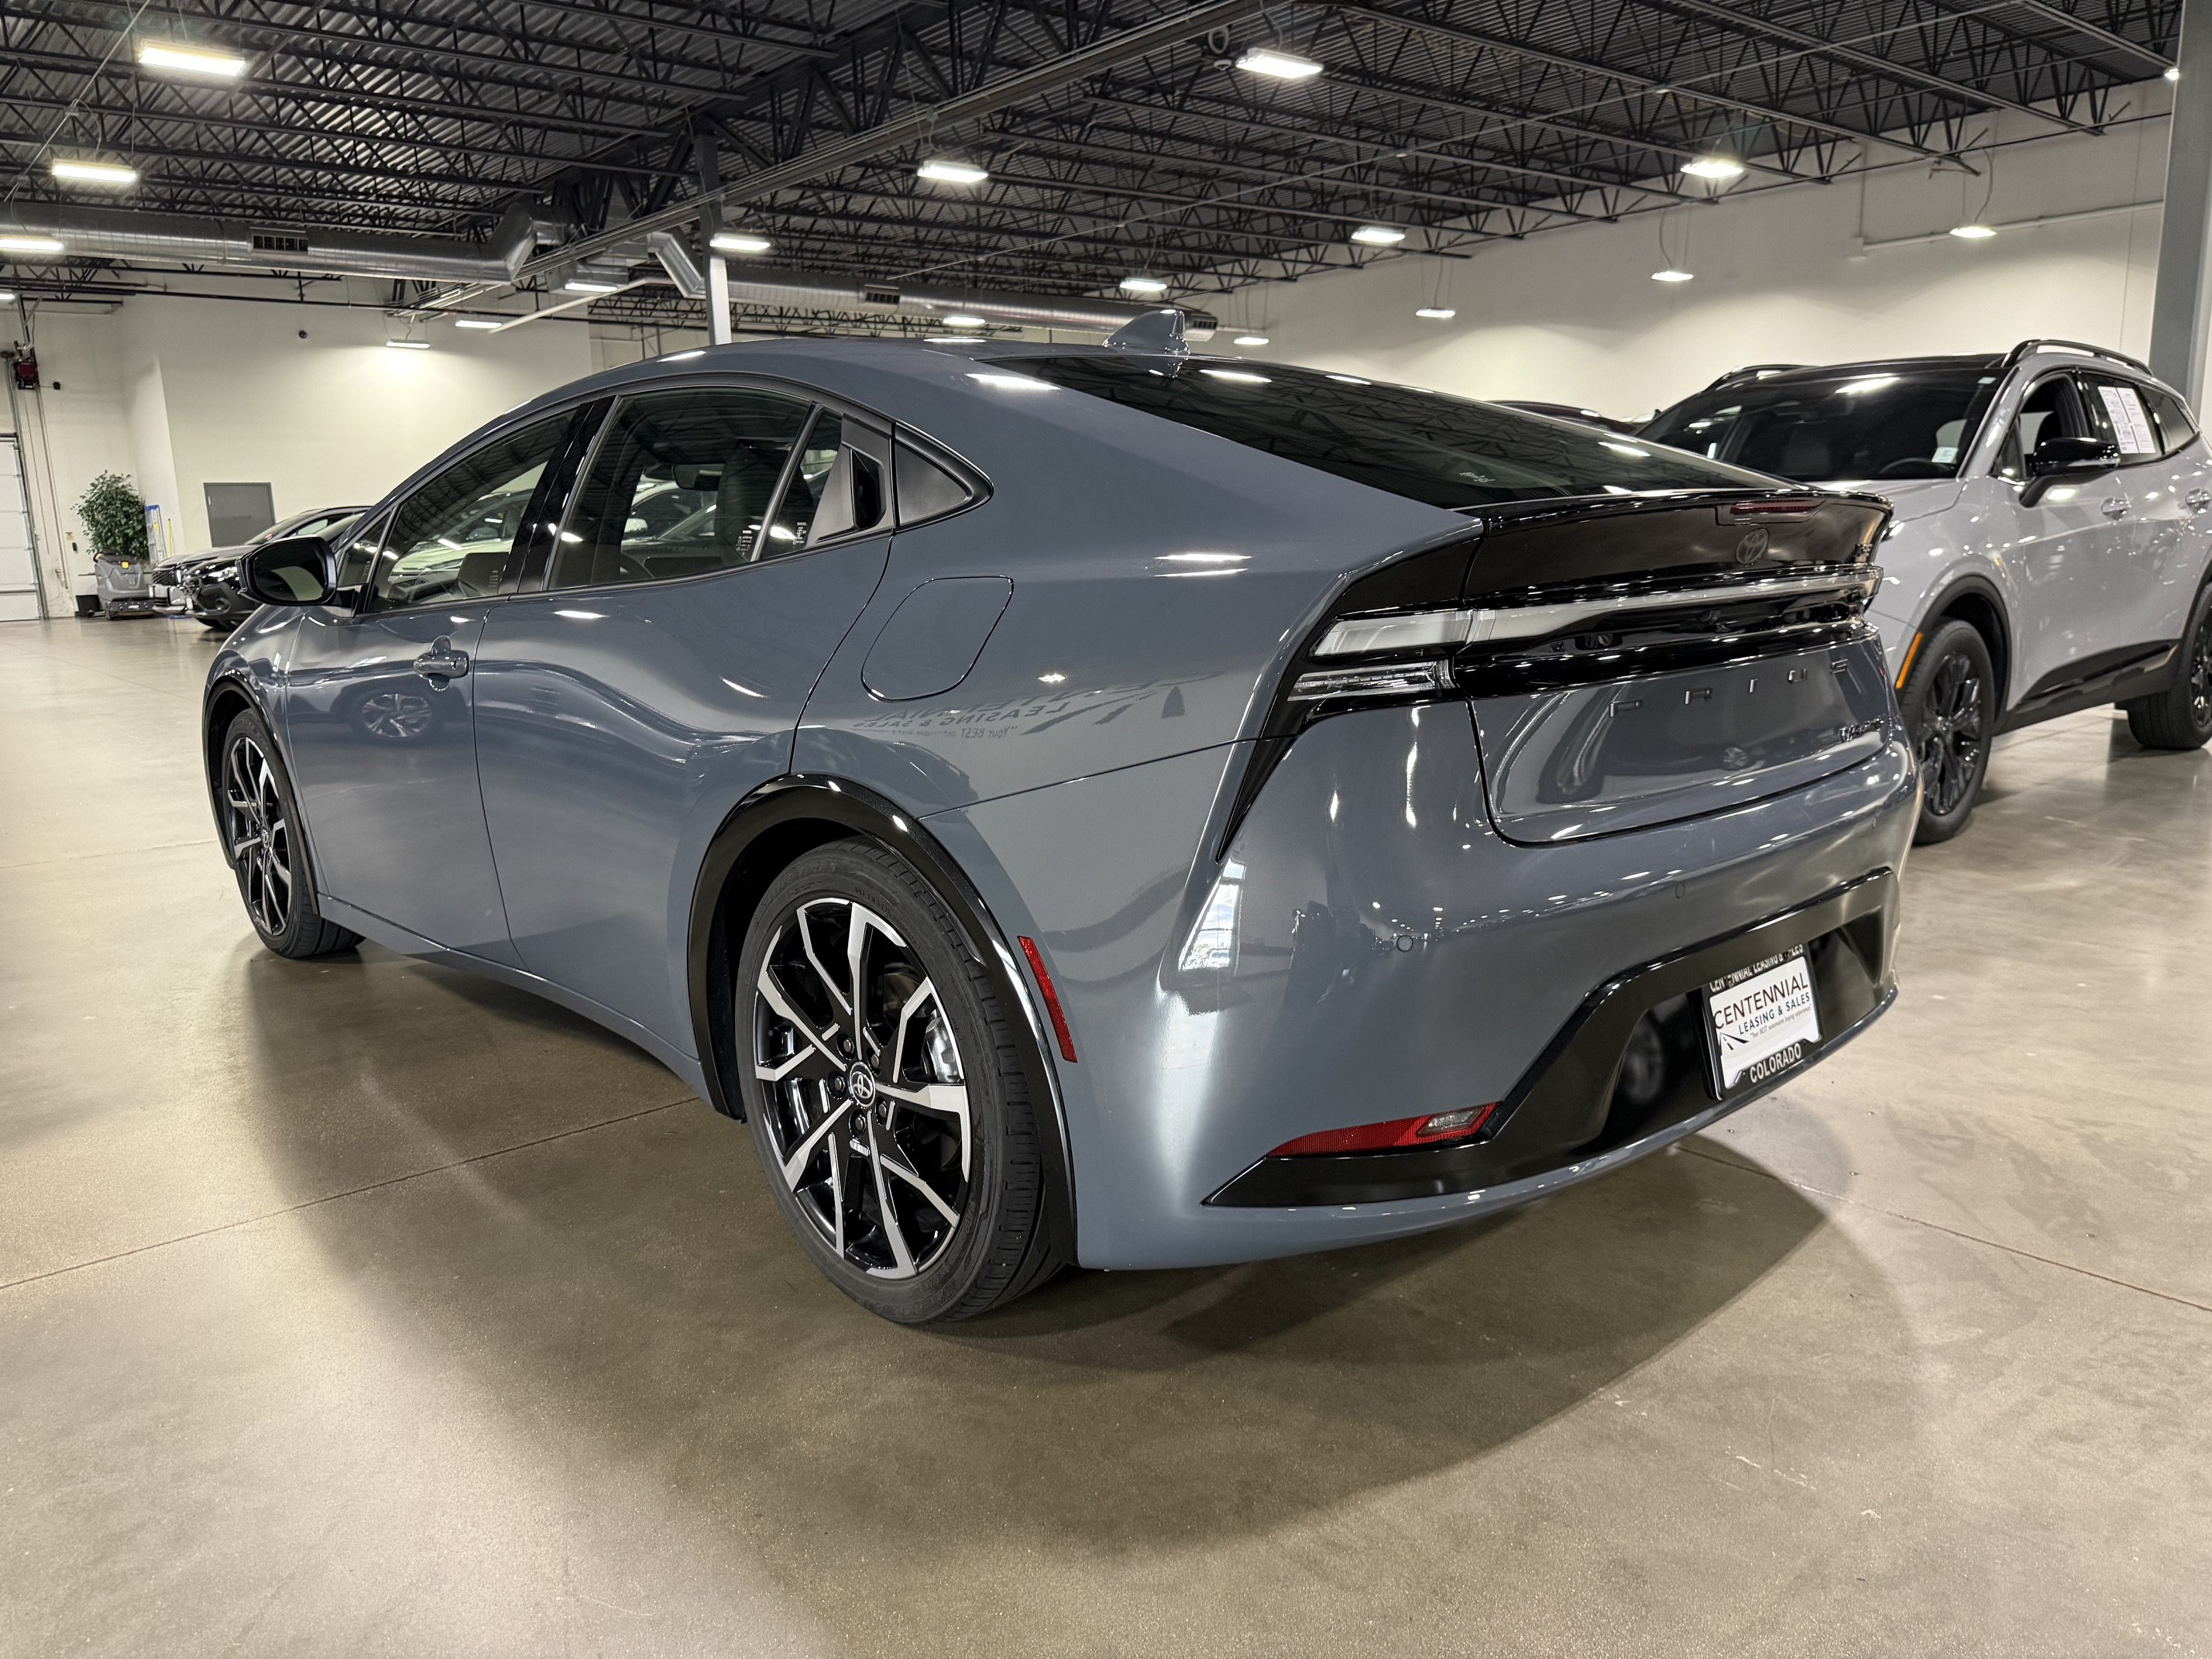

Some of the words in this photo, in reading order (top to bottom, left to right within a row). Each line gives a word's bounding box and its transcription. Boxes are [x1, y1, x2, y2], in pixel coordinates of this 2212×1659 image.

[1609, 658, 1848, 717] PRIUS
[1714, 972, 1808, 1029] CENTENNIAL
[1739, 1009, 1775, 1035] LEASING
[1778, 1005, 1783, 1015] &
[1785, 992, 1810, 1012] SALES
[1750, 1042, 1802, 1084] COLORADO
